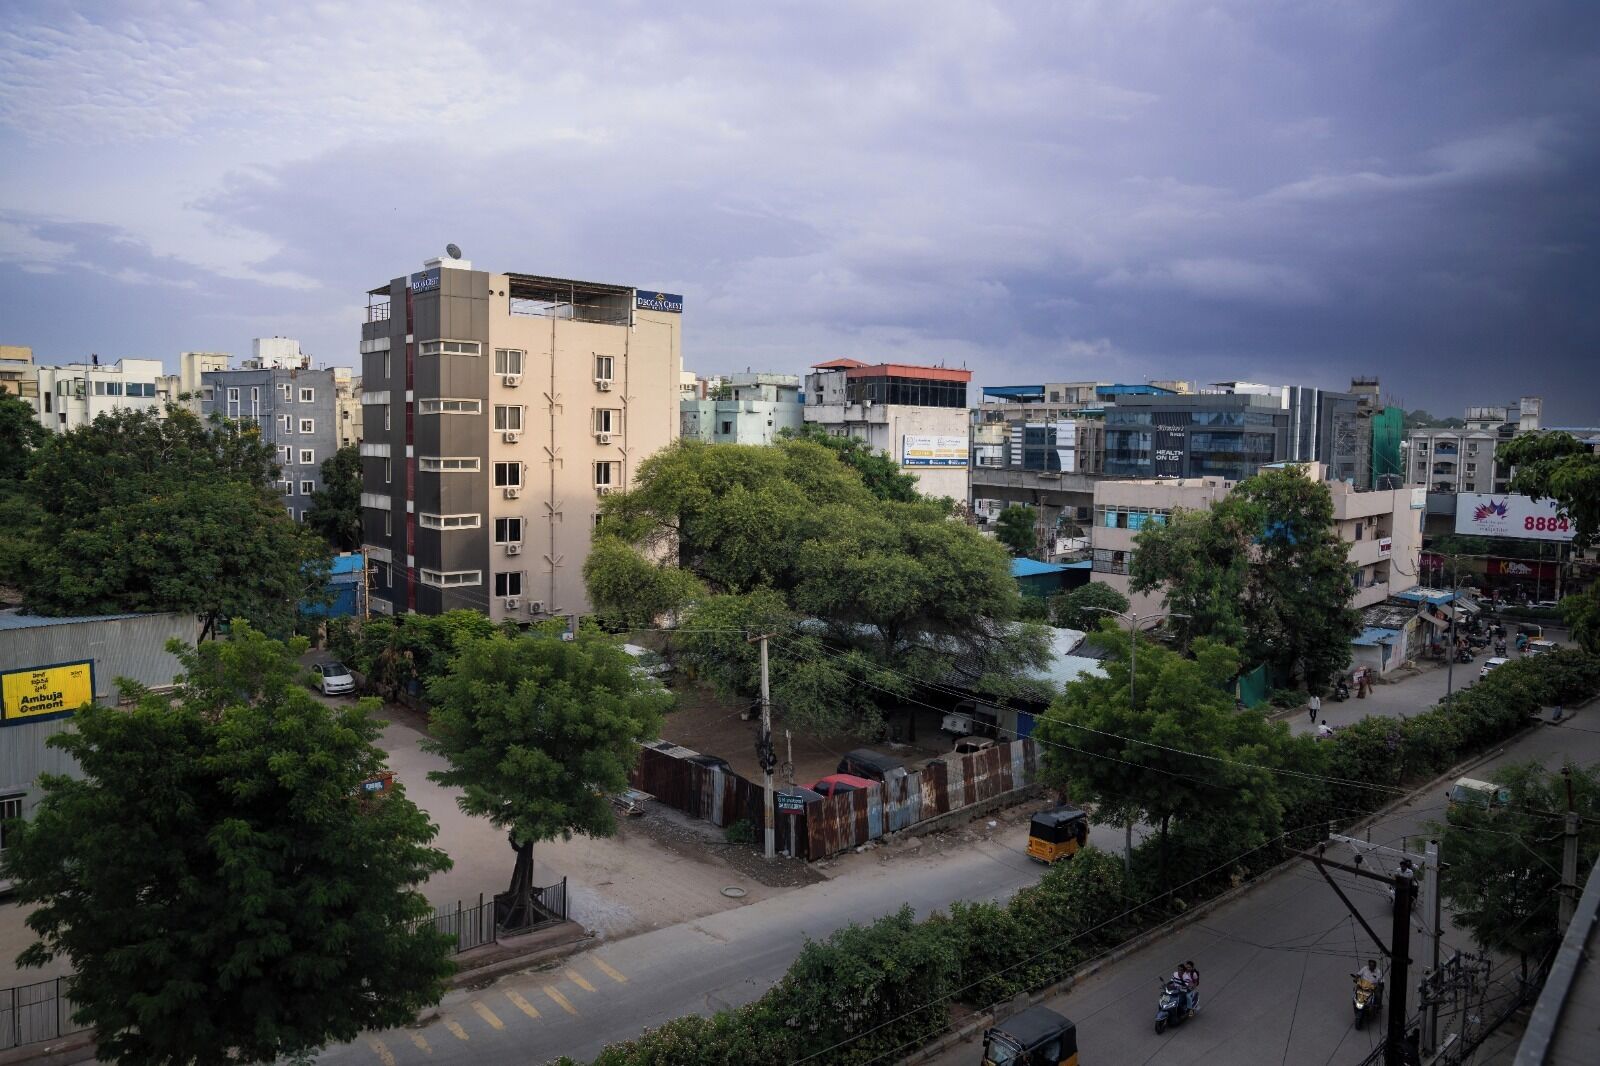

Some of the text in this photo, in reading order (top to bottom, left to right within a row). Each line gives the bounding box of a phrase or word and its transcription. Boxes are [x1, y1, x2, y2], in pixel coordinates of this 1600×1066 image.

[638, 298, 662, 306] DECCAN
[663, 300, 682, 309] CREST
[21, 692, 62, 704] Ambuja
[20, 700, 64, 712] Cement
